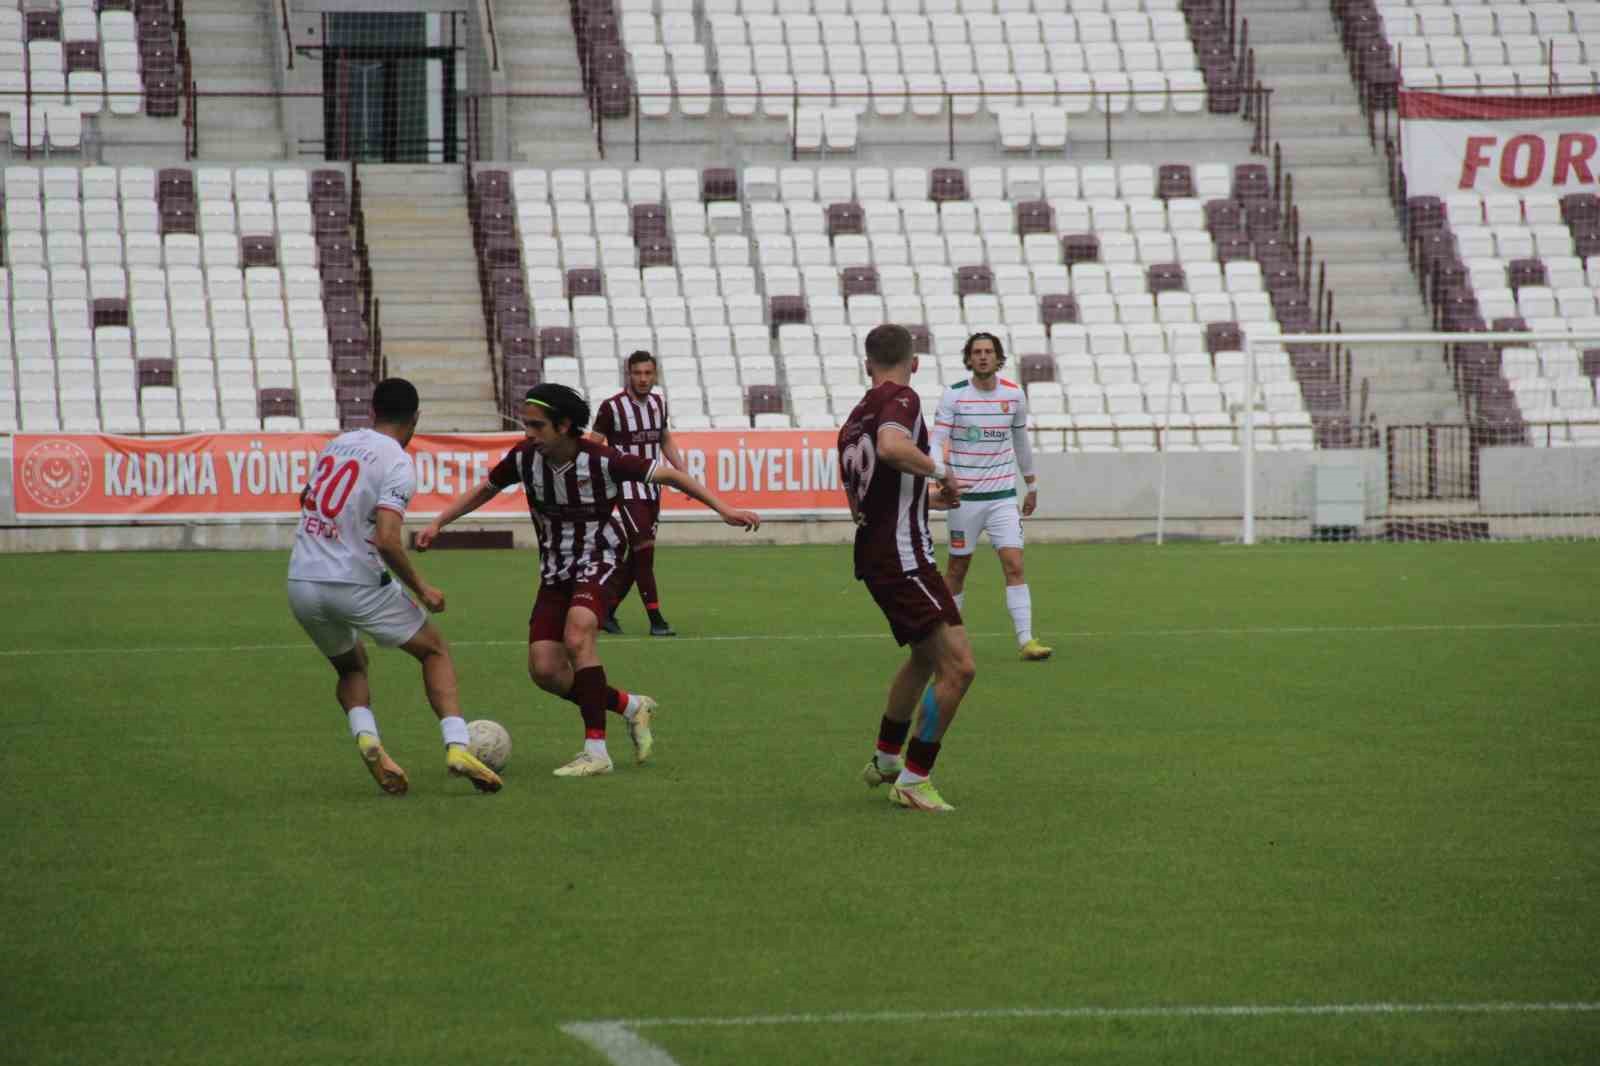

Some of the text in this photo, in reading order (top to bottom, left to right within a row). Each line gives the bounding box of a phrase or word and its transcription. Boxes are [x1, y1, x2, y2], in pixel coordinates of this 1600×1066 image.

[1458, 132, 1600, 190] FOR
[103, 452, 218, 497] KADINA
[415, 451, 489, 496] DETE
